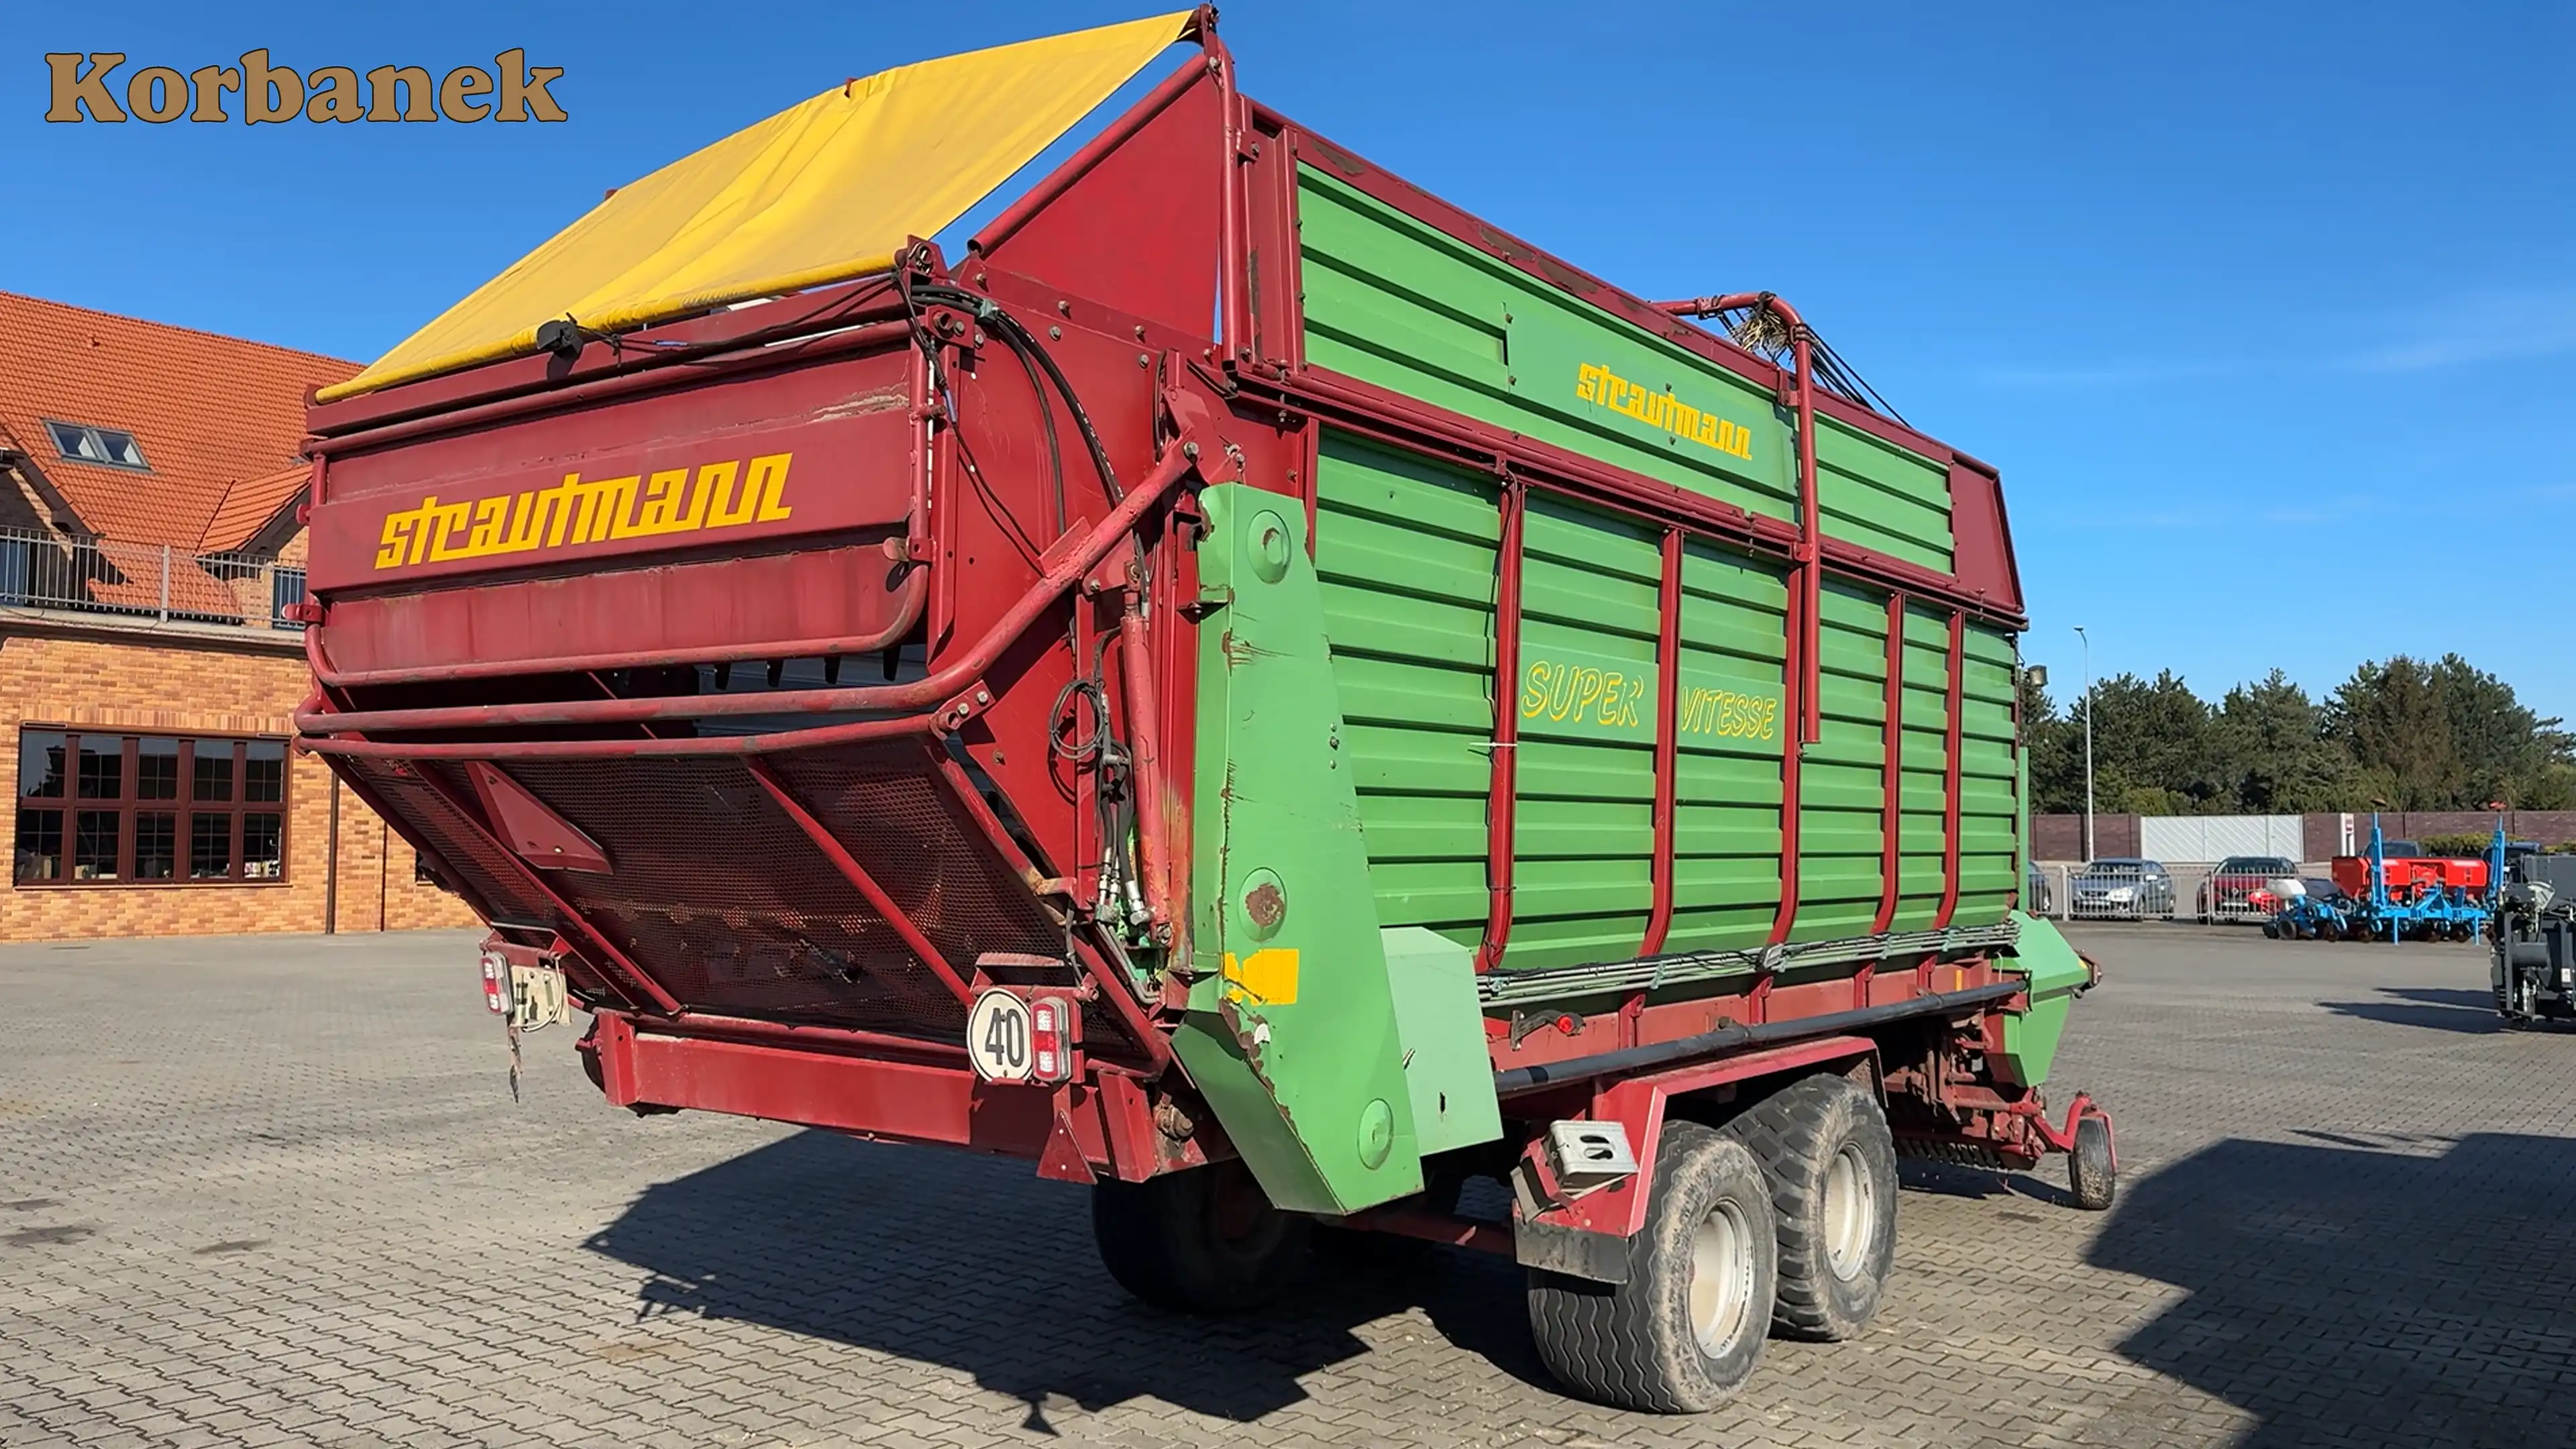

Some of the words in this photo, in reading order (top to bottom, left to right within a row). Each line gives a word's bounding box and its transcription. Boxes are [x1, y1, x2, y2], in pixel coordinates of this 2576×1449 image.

[1521, 660, 1644, 728] SUPER
[1680, 685, 1778, 741] VITESSE
[985, 1007, 1024, 1067] 40
